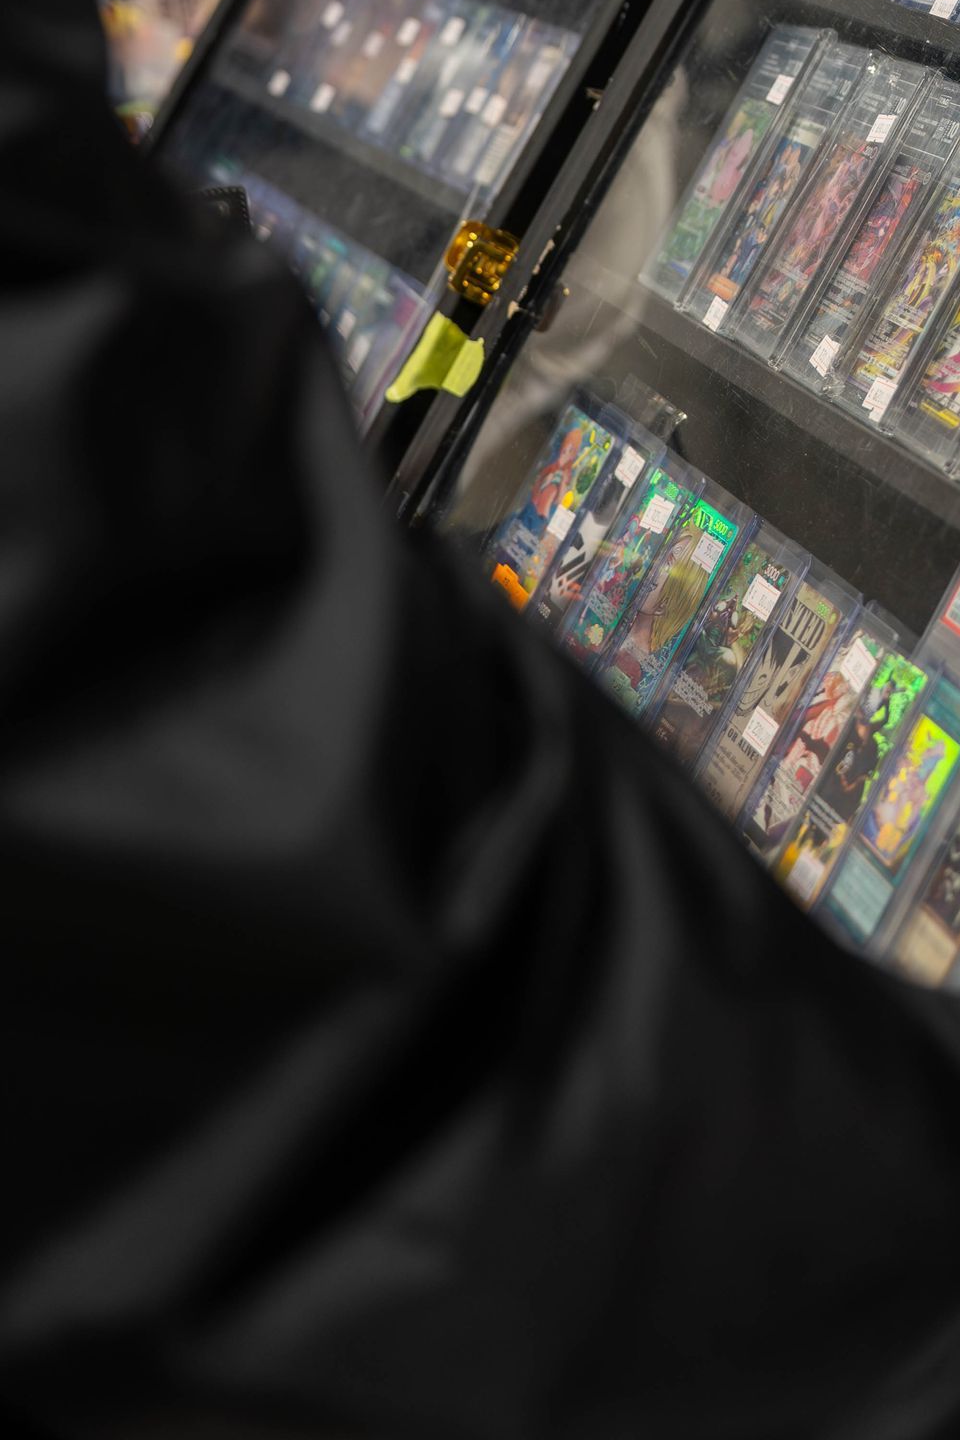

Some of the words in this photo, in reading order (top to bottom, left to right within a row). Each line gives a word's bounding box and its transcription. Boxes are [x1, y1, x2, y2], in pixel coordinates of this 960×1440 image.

[946, 121, 960, 139] 10
[713, 519, 728, 535] 5000
[764, 563, 781, 581] 3000
[779, 596, 826, 651] NTED
